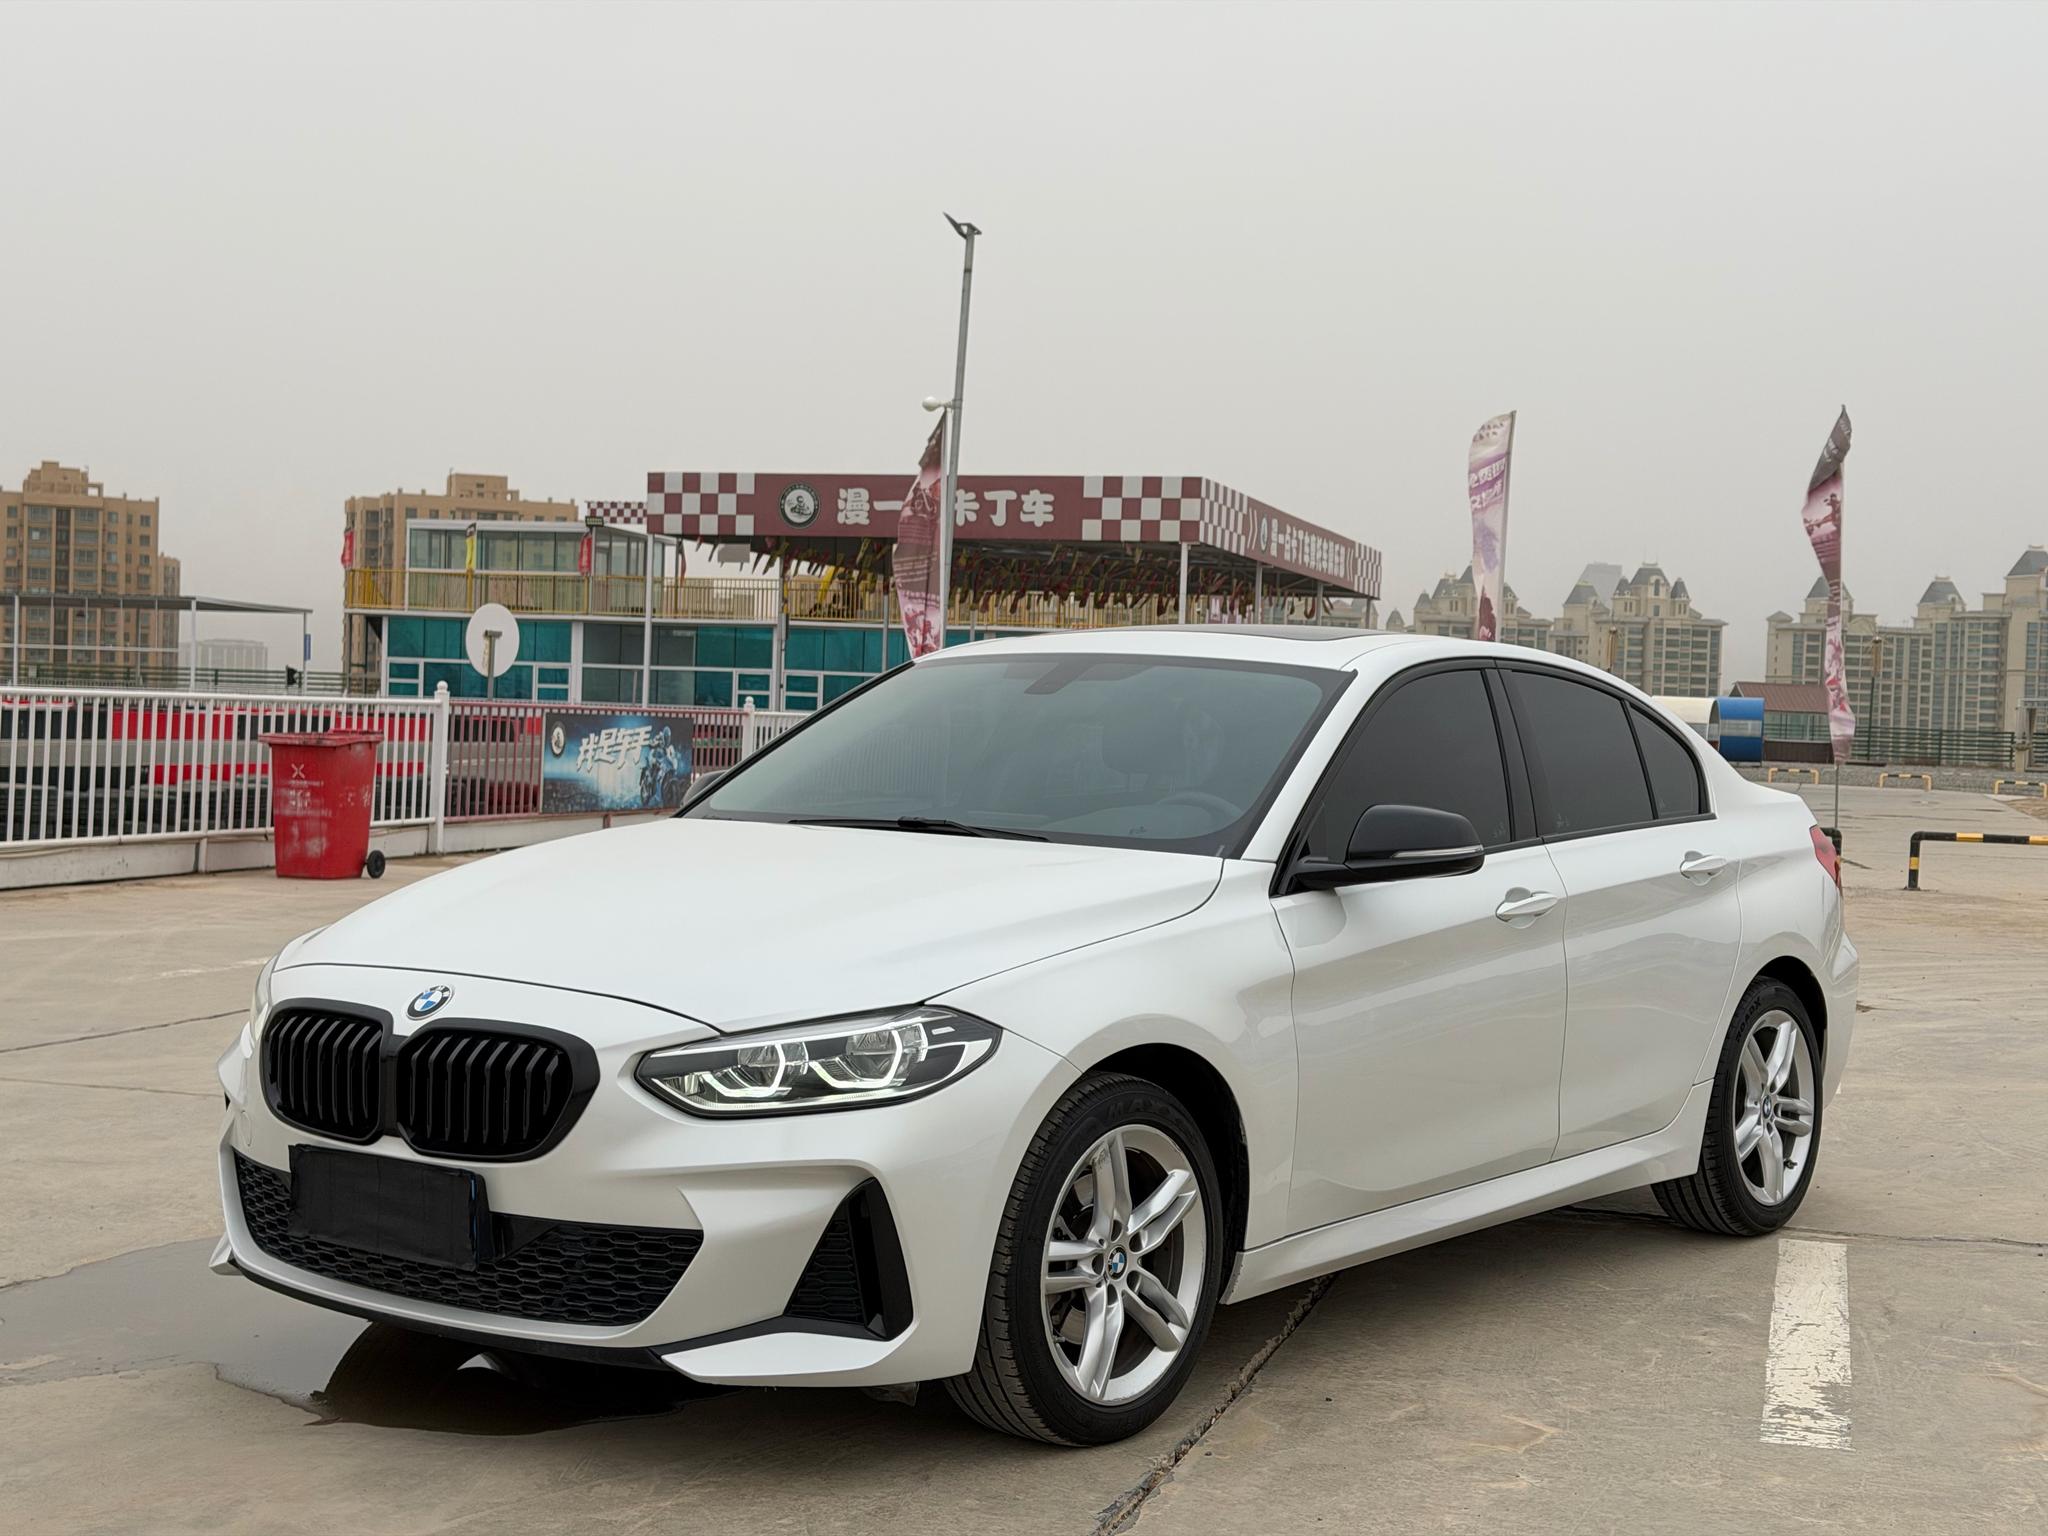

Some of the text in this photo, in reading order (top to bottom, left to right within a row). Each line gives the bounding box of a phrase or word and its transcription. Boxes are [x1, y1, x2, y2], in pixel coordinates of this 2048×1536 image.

[836, 487, 1056, 527] 漫一卡丁车
[576, 724, 653, 773] 我是车手
